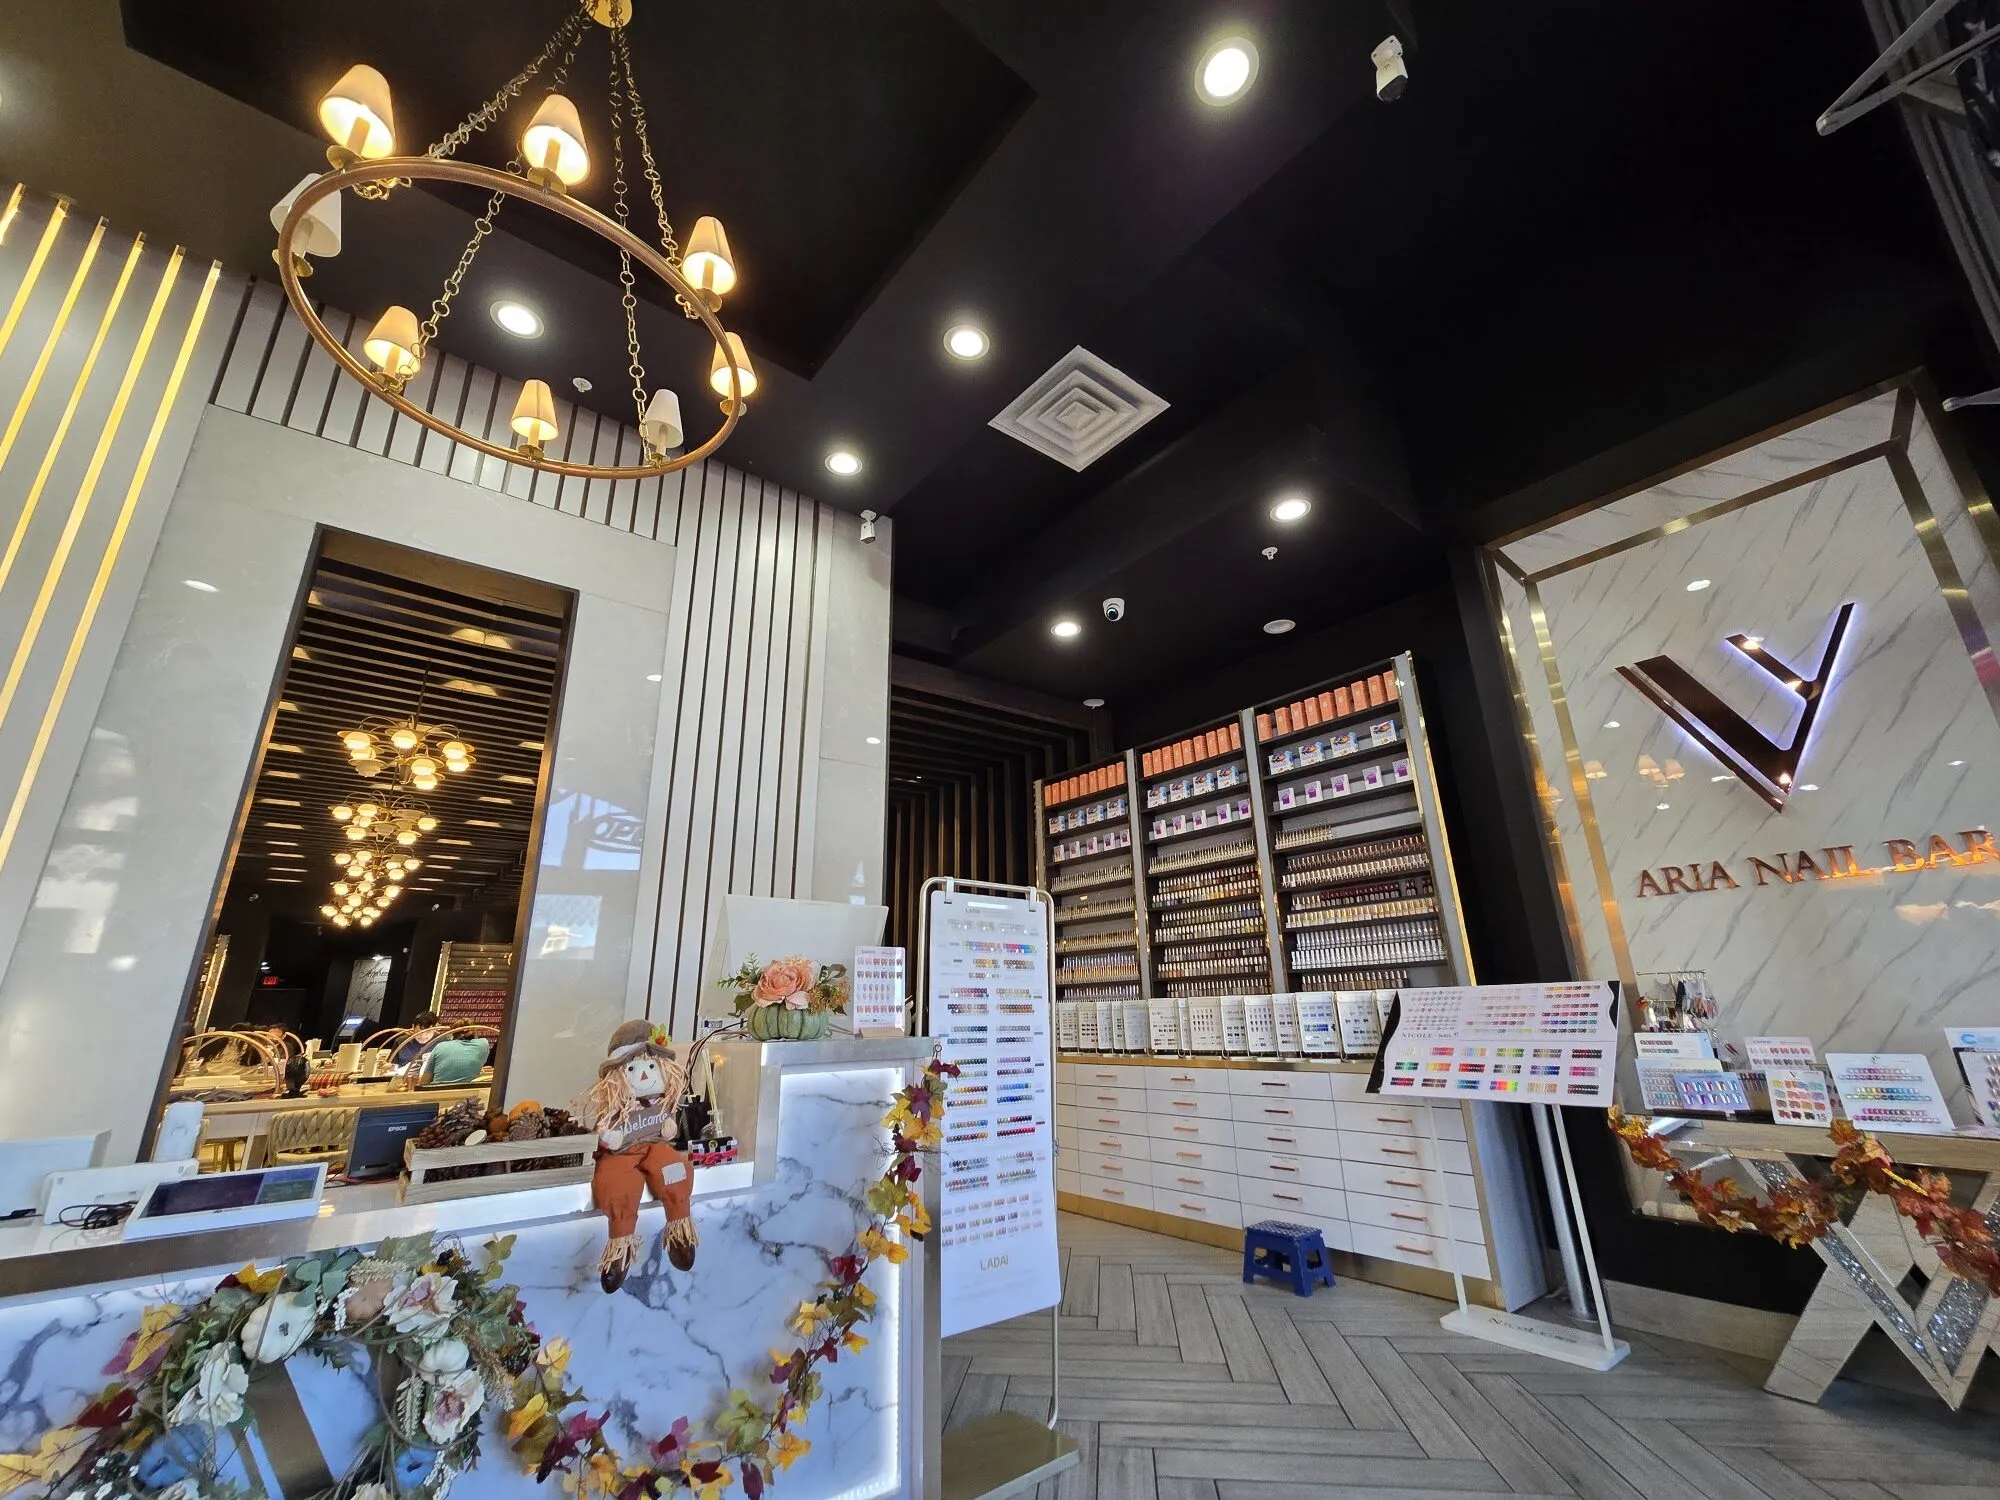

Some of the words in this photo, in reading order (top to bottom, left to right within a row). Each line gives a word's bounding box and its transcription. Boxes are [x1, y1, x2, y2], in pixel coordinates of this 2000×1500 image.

[1636, 860, 1741, 898] ARIA
[1746, 844, 1874, 886] NAIL
[1880, 829, 2000, 872] BAR
[263, 976, 279, 985] EXIT
[619, 1113, 668, 1137] Welcome
[1816, 1113, 1827, 1121] 15
